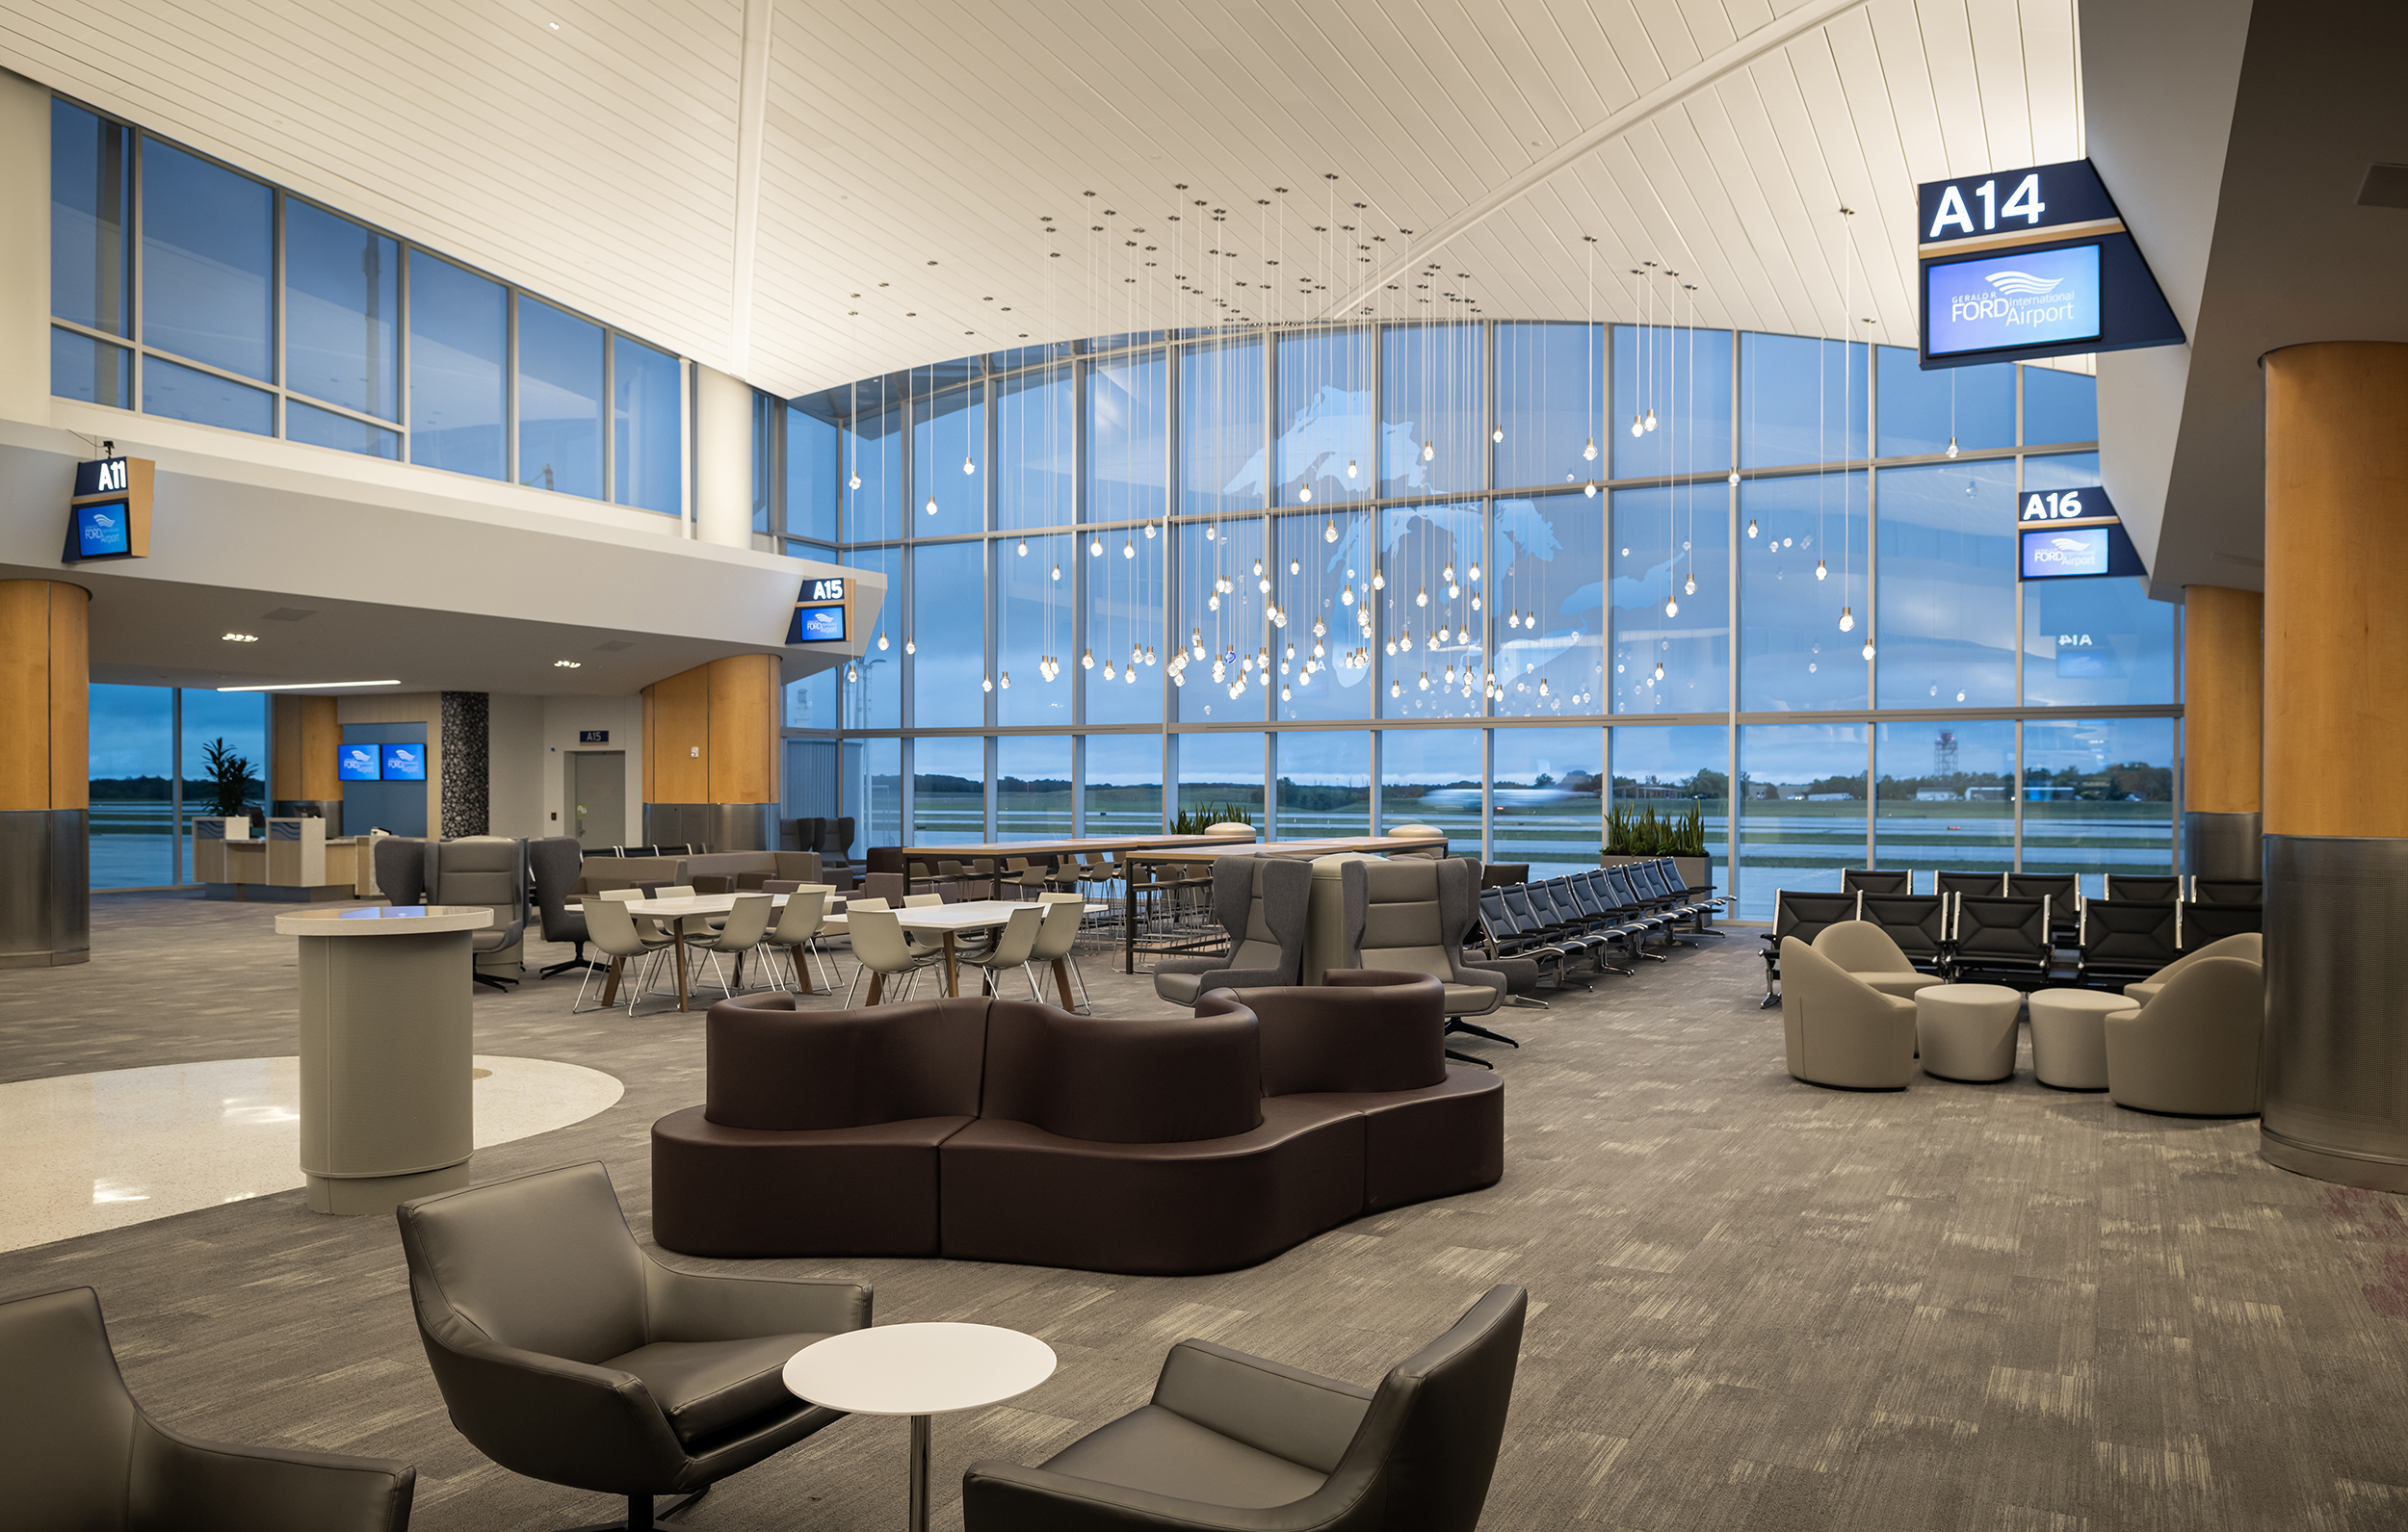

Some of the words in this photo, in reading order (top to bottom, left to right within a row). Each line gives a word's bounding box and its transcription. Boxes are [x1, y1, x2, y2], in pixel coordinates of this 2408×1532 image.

[1929, 173, 2046, 238] A14
[1951, 292, 1989, 303] GERALD
[2009, 290, 2075, 307] International
[1951, 298, 2010, 324] FORD
[2005, 301, 2075, 328] Airport
[98, 460, 126, 491] A11
[2023, 490, 2082, 521] A16
[2034, 551, 2064, 562] FORD
[2061, 556, 2096, 567] Airport
[813, 579, 843, 600] A15
[806, 621, 823, 631] FORD
[586, 732, 602, 741] A15
